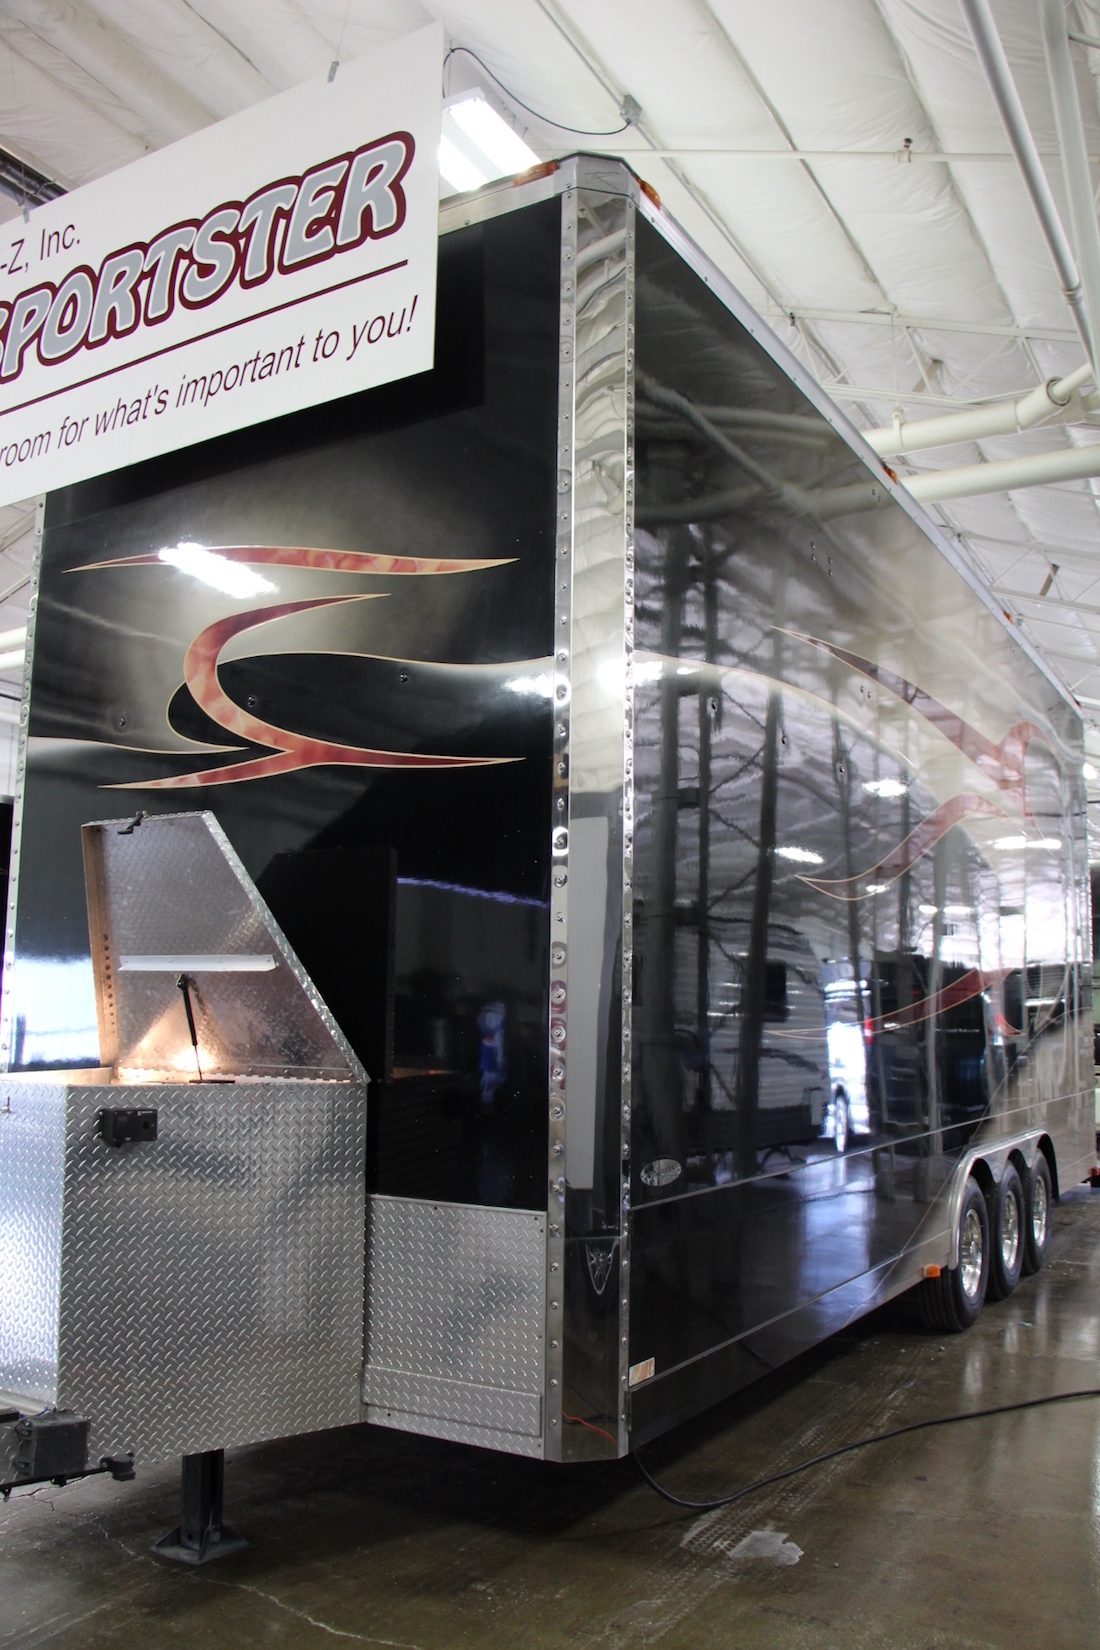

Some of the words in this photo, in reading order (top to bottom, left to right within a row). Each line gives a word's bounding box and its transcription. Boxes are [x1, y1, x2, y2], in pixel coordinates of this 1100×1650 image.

[0, 130, 416, 385] PORTSTER
[40, 224, 80, 261] Inc.
[57, 416, 89, 449] for
[94, 384, 169, 436] what's
[175, 334, 305, 408] important
[312, 328, 340, 363] to
[346, 294, 418, 361] you!
